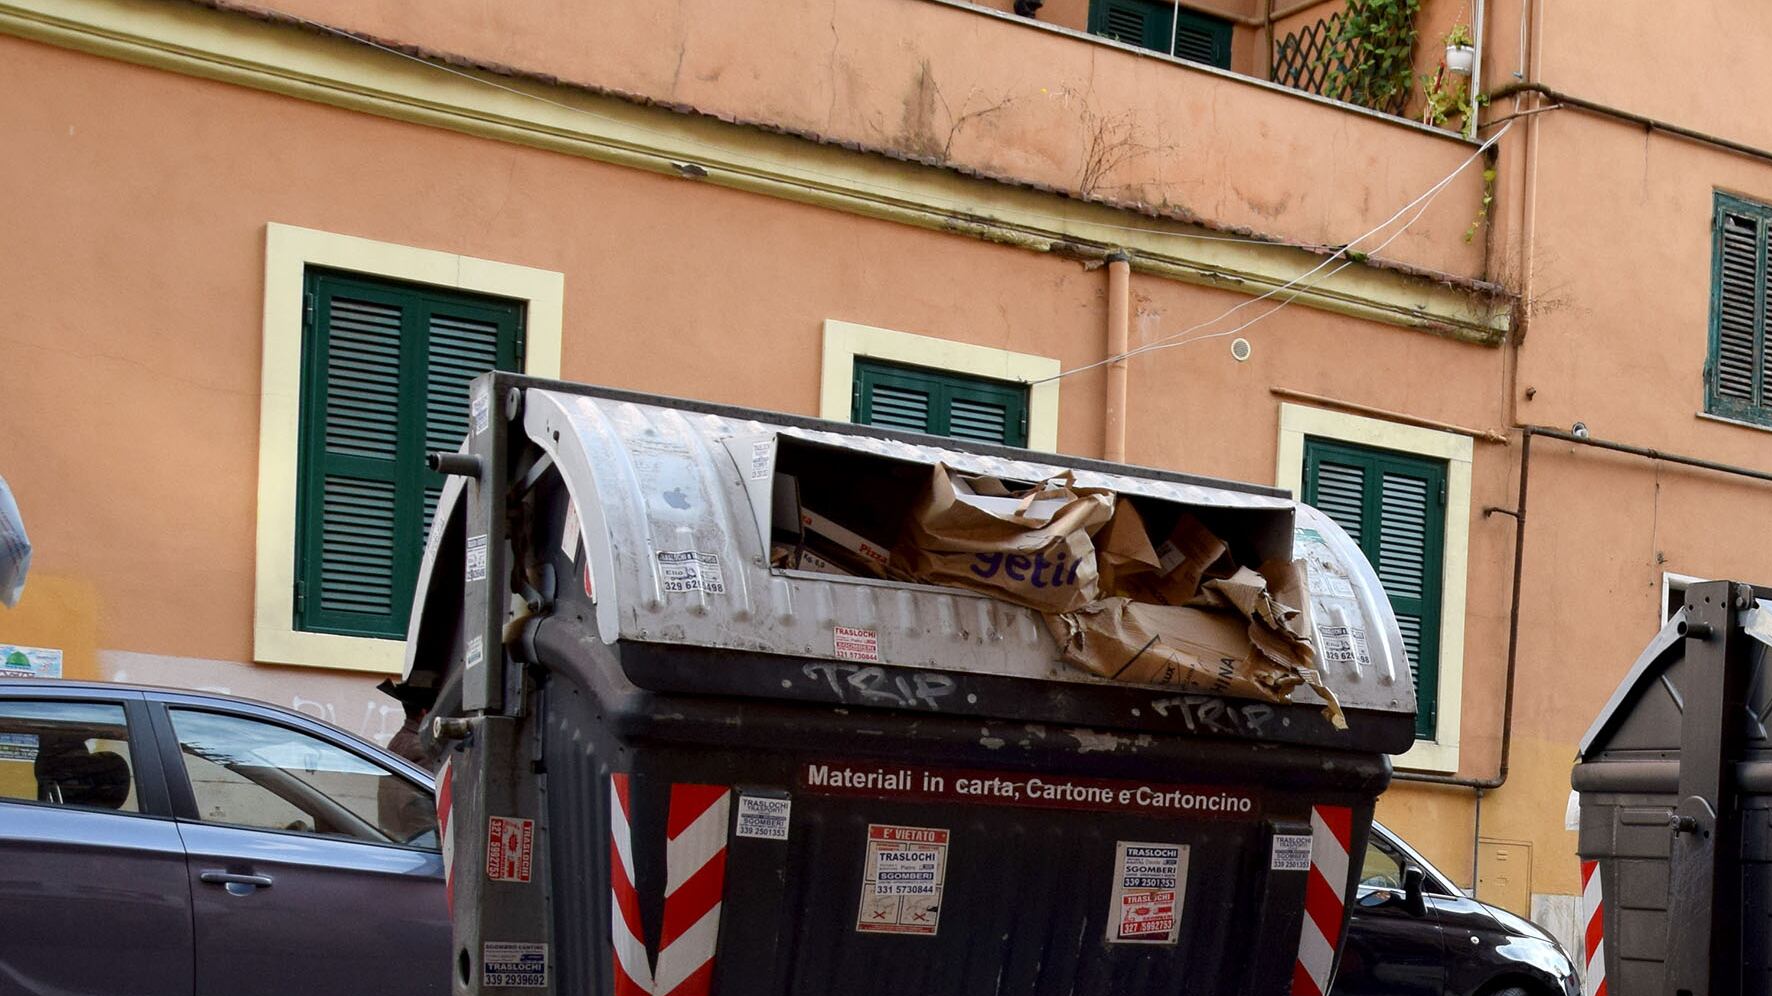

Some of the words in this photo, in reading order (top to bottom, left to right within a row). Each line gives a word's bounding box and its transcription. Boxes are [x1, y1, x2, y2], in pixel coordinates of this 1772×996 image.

[808, 764, 912, 791] Materiali
[923, 771, 944, 792] in
[1026, 778, 1113, 803] Cartone
[1118, 788, 1131, 804] e
[1136, 786, 1252, 812] Cartoncino
[742, 799, 788, 808] TRASLOCHI
[895, 829, 935, 841] VIETATO
[522, 826, 531, 877] TRASLOCHI
[1128, 849, 1177, 857] TRASLOCHI
[880, 852, 936, 861] TRASLOCHI
[1126, 866, 1176, 874] SGOMBERI
[1125, 878, 1139, 887] 339
[877, 886, 893, 894] 331
[896, 886, 933, 894] 5730844
[1124, 923, 1138, 934] 327
[486, 974, 502, 985] 339
[505, 974, 545, 985] 2939692
